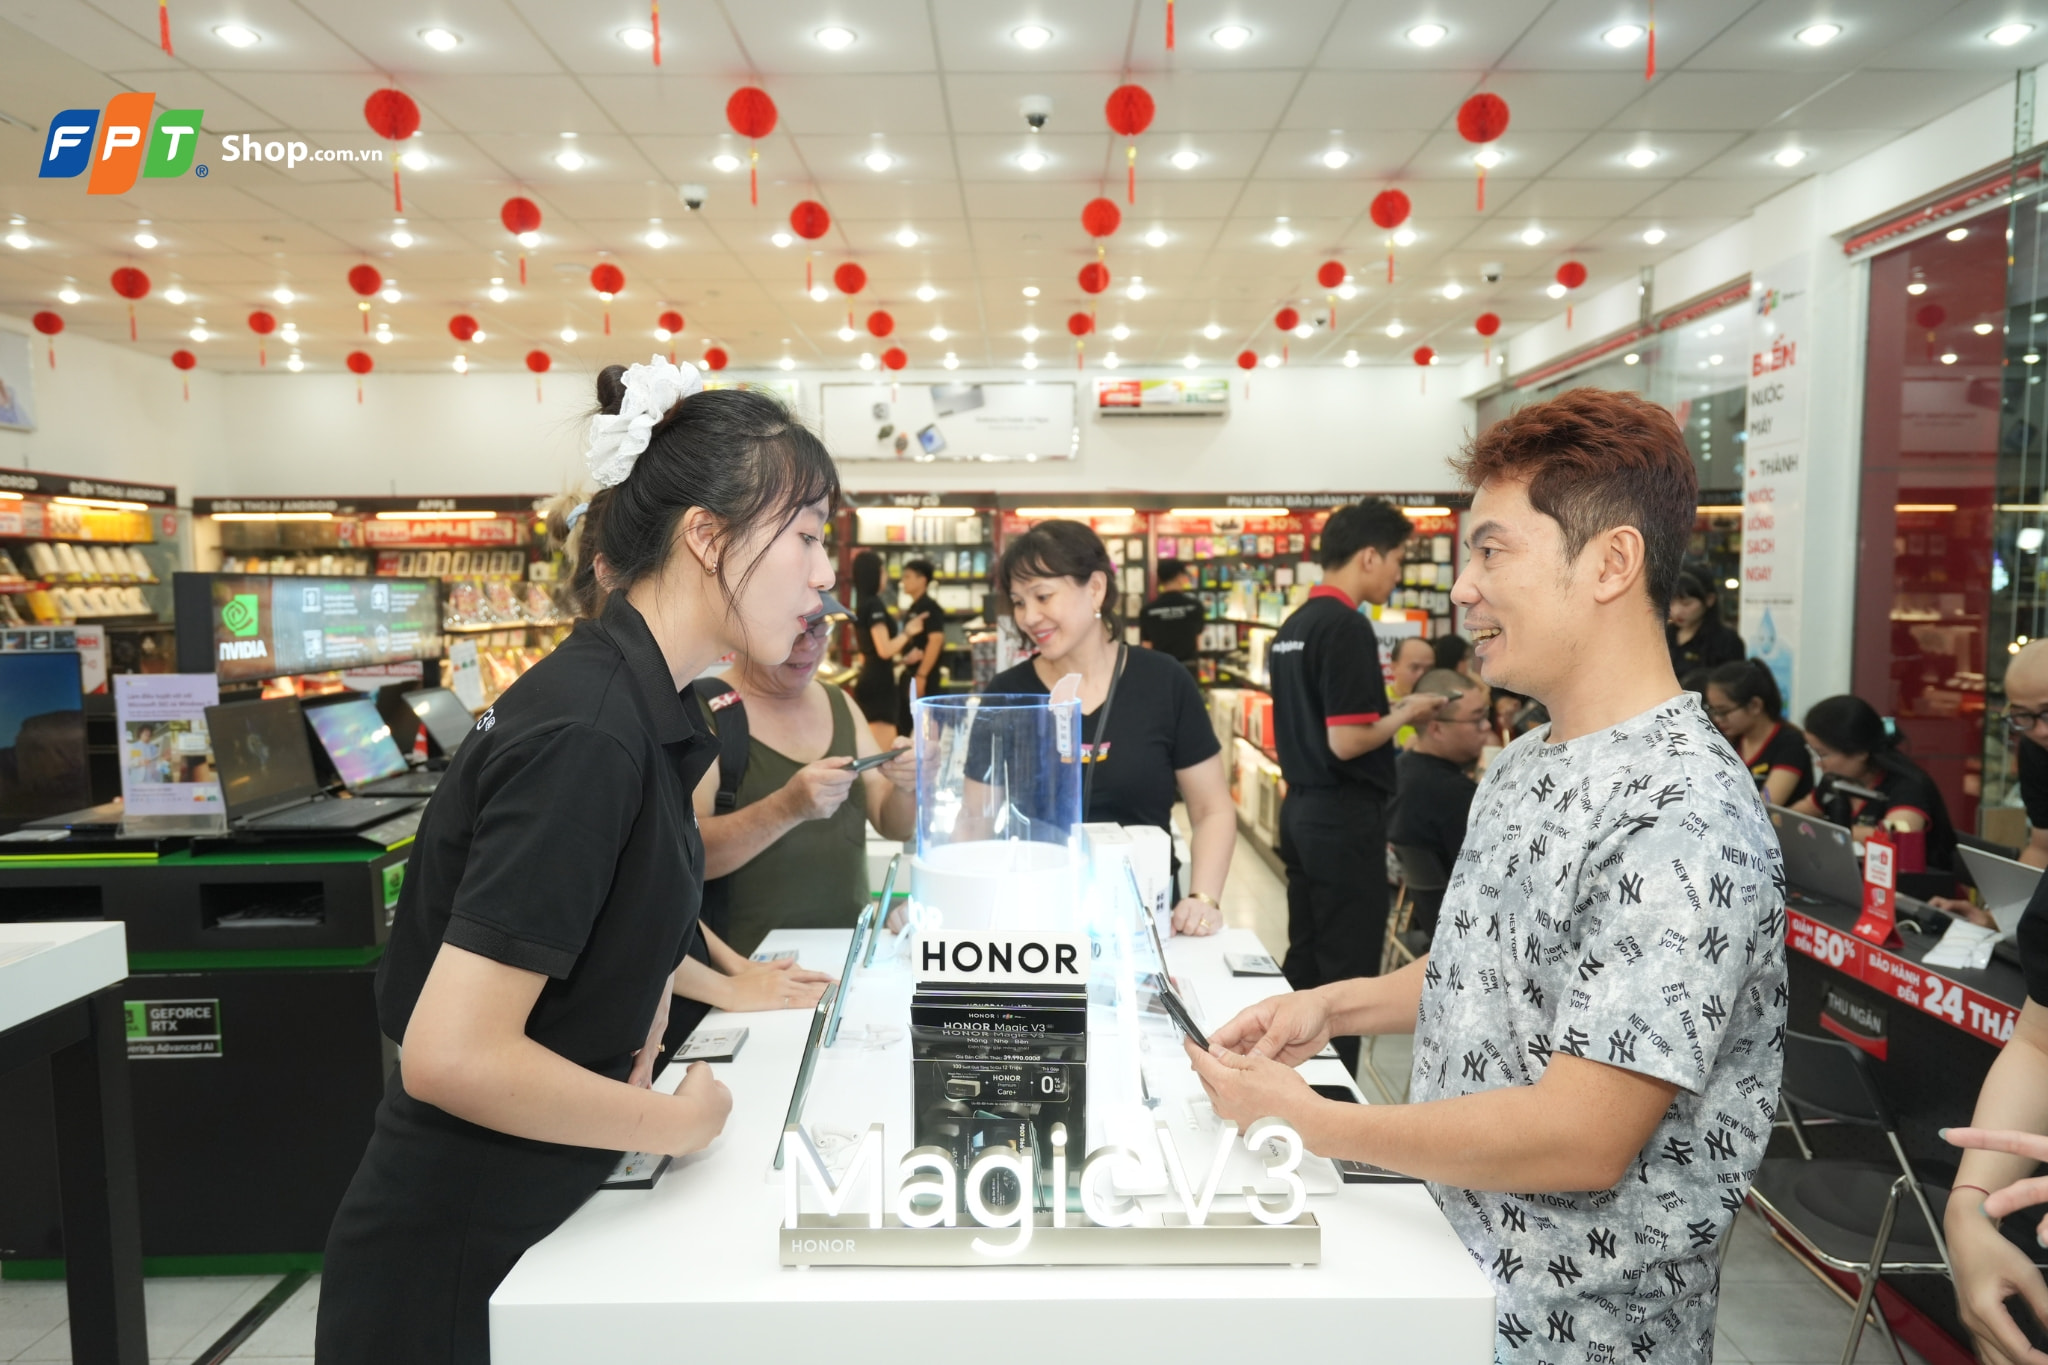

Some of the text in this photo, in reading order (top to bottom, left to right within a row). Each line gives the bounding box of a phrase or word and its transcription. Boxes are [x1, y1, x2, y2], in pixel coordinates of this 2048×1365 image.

[418, 499, 456, 510] APPLE
[412, 521, 469, 538] APPLE
[1745, 565, 1773, 583] NGAY
[219, 640, 268, 661] NVIDIA
[1680, 819, 1706, 840] york
[1688, 811, 1709, 831] new
[1595, 852, 1624, 871] YORK
[1722, 845, 1766, 874] NEW YO
[1479, 884, 1501, 899] ORK
[1672, 859, 1702, 912] NEW YORK
[1740, 884, 1756, 893] new
[1553, 919, 1571, 933] YO
[1665, 928, 1688, 944] new
[1543, 943, 1563, 955] new
[1614, 940, 1635, 966] york
[1625, 936, 1643, 959] new
[1659, 937, 1685, 955] york
[1813, 927, 1856, 968] 50%
[923, 941, 1078, 974] HONOR
[1545, 949, 1568, 965] york
[1478, 969, 1491, 994] york
[1488, 968, 1499, 990] new
[1890, 964, 1920, 987] HÀNH
[1572, 989, 1592, 1001] new
[1662, 981, 1685, 994] new
[1569, 998, 1590, 1011] york
[1664, 990, 1691, 1006] york
[1828, 992, 1848, 1015] THU
[150, 1007, 211, 1020] GEFORCE
[1923, 976, 1964, 1025] 24
[1968, 1000, 2016, 1043] THÁ
[151, 1021, 178, 1031] RTX
[1628, 1013, 1673, 1058] NEW YORK
[1680, 1010, 1706, 1078] NEW YORK
[156, 1042, 202, 1053] Advanced
[1731, 1046, 1751, 1055] york
[1482, 1039, 1514, 1083] NEW YORK
[1041, 1075, 1054, 1093] 0
[1736, 1074, 1758, 1089] new
[1740, 1080, 1764, 1099] york
[1716, 1112, 1759, 1144] NEW YORK
[1717, 1169, 1758, 1183] NEW YOR
[784, 1116, 1309, 1258] Magic V3
[1655, 1189, 1677, 1202] new
[1539, 1193, 1578, 1210] YORK
[1592, 1190, 1619, 1208] york
[1662, 1196, 1687, 1212] york
[1463, 1189, 1494, 1235] NEW YORK
[1644, 1224, 1669, 1241] new
[791, 1239, 856, 1253] HONOR
[1467, 1248, 1485, 1264] new
[1595, 1296, 1620, 1317] YORK
[1626, 1313, 1646, 1324] ork
[1661, 1312, 1677, 1335] york
[1588, 1340, 1615, 1353] new
[1586, 1352, 1616, 1365] york
